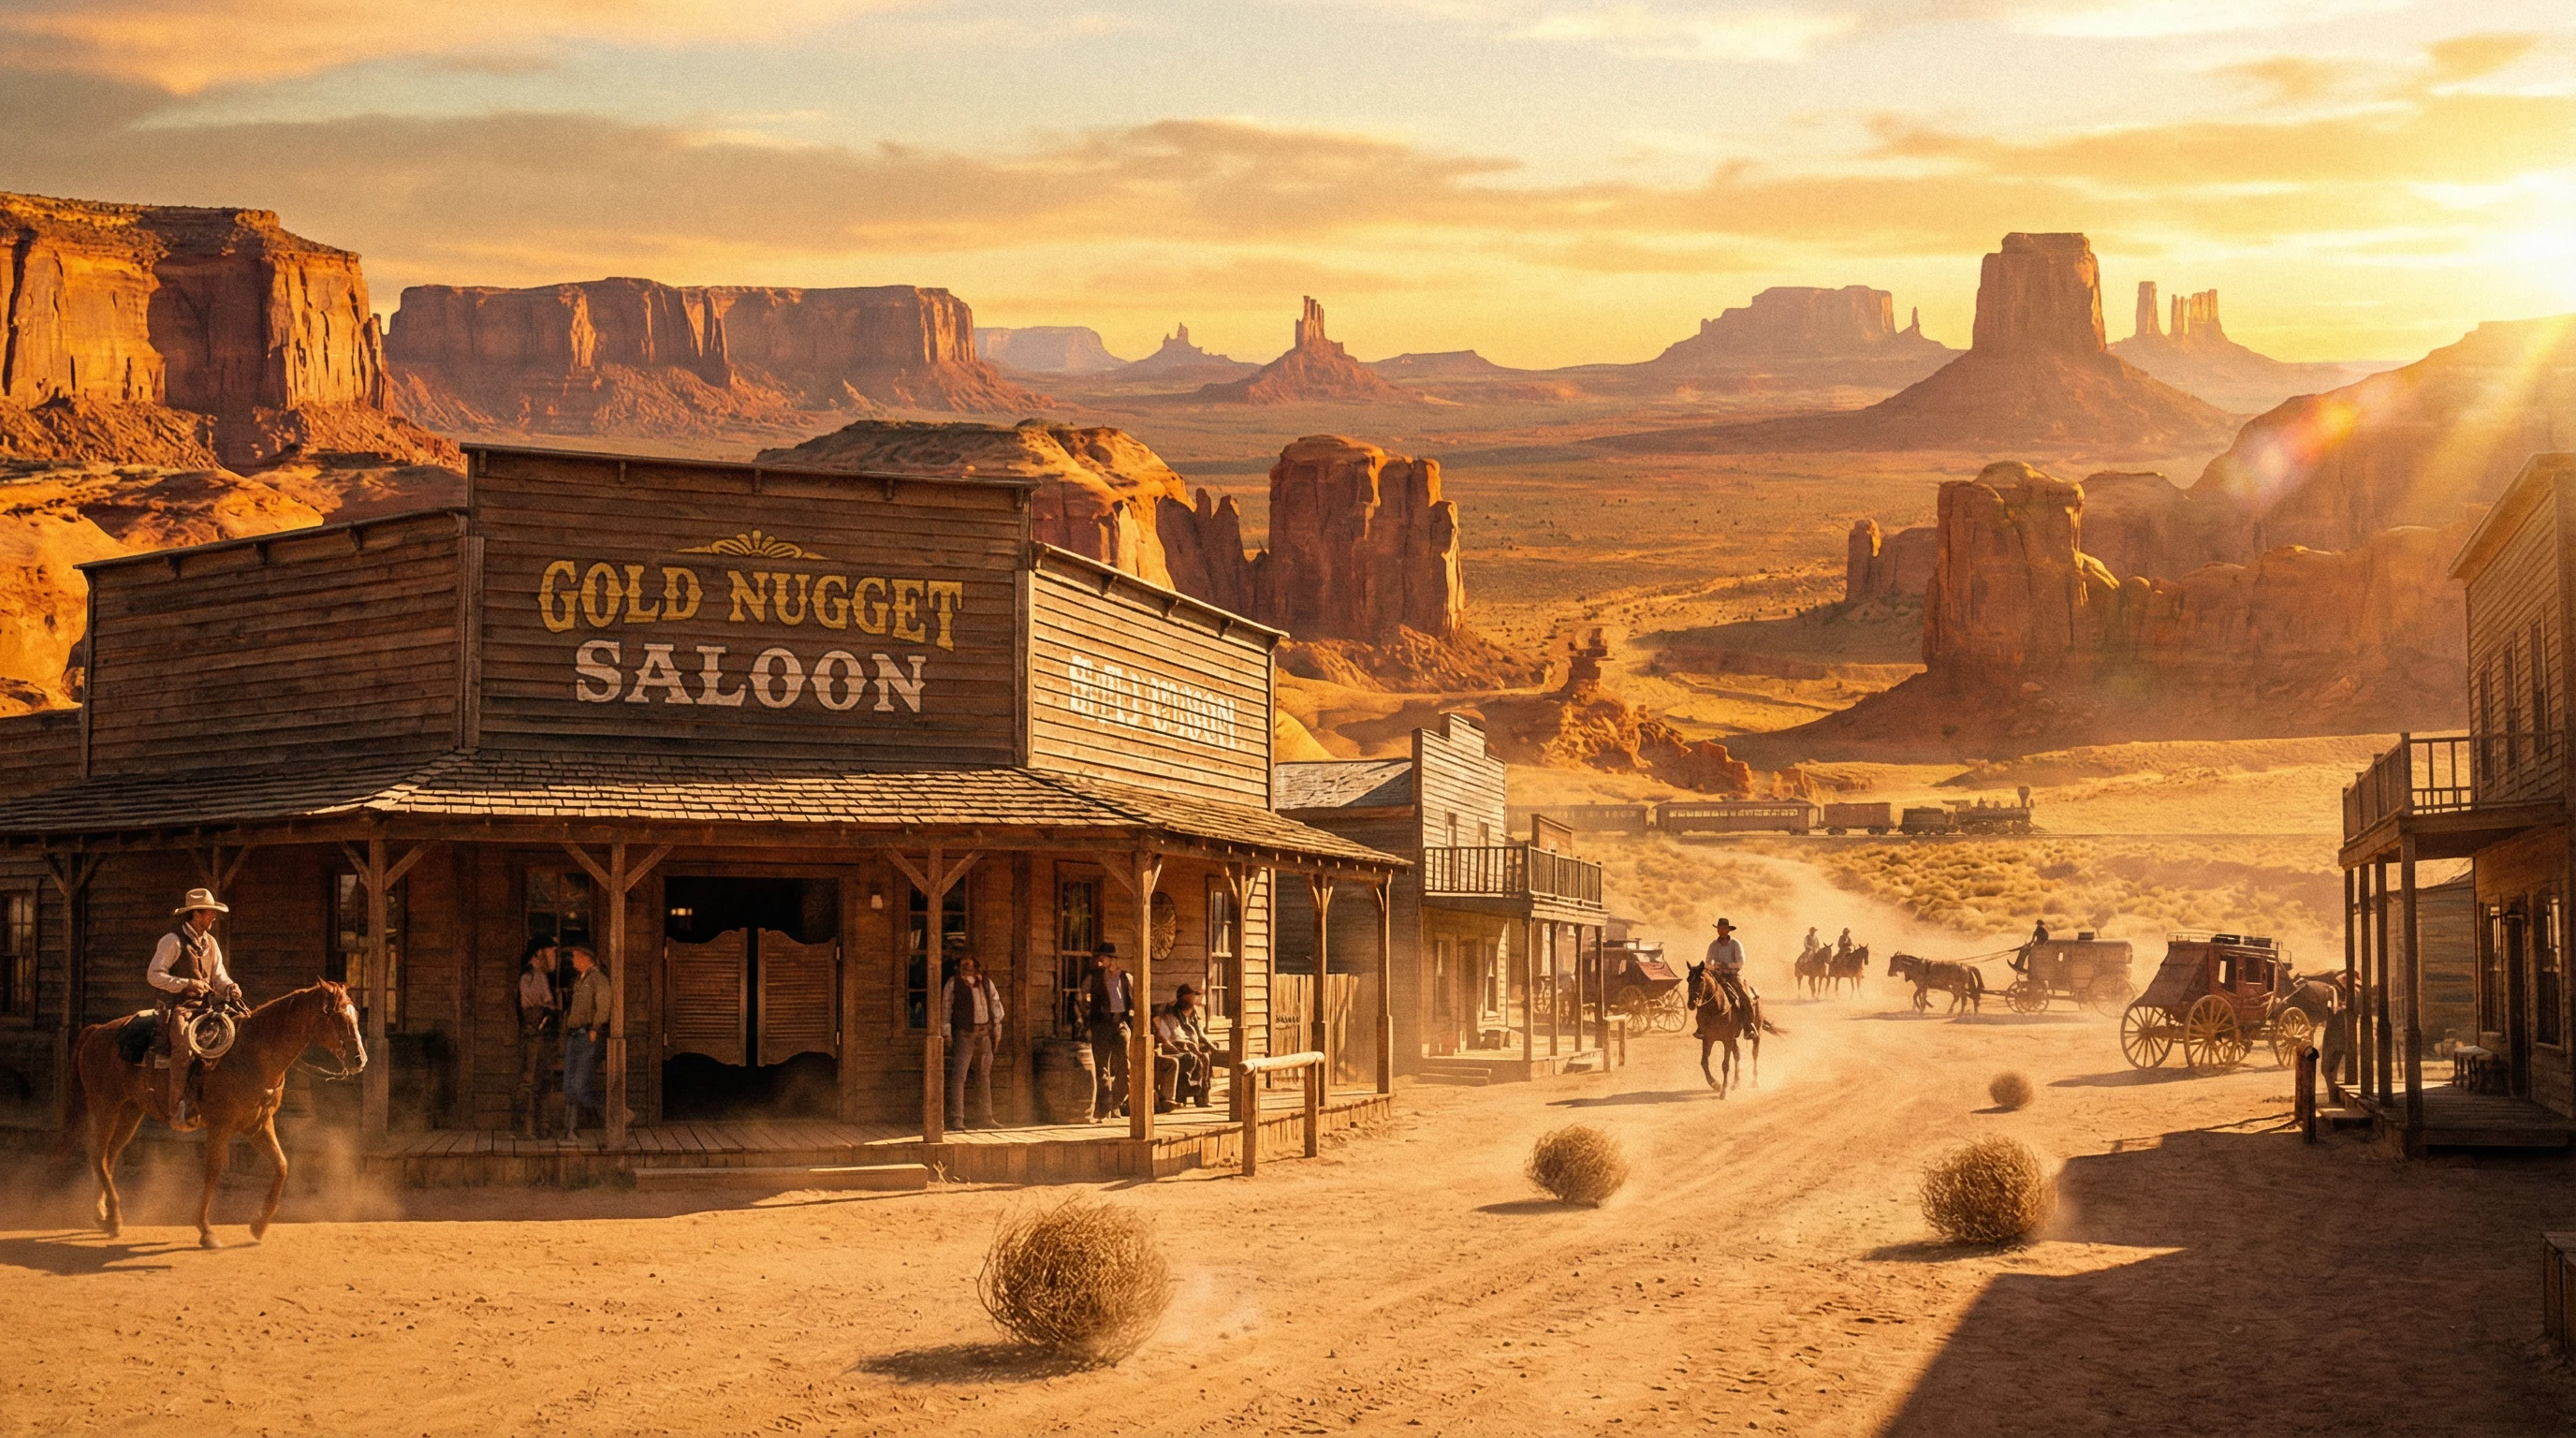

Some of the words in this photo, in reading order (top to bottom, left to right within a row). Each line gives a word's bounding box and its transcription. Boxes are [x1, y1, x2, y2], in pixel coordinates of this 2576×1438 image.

[537, 560, 704, 633] GOLD
[728, 570, 963, 653] NUGGET
[575, 639, 927, 713] SALOON
